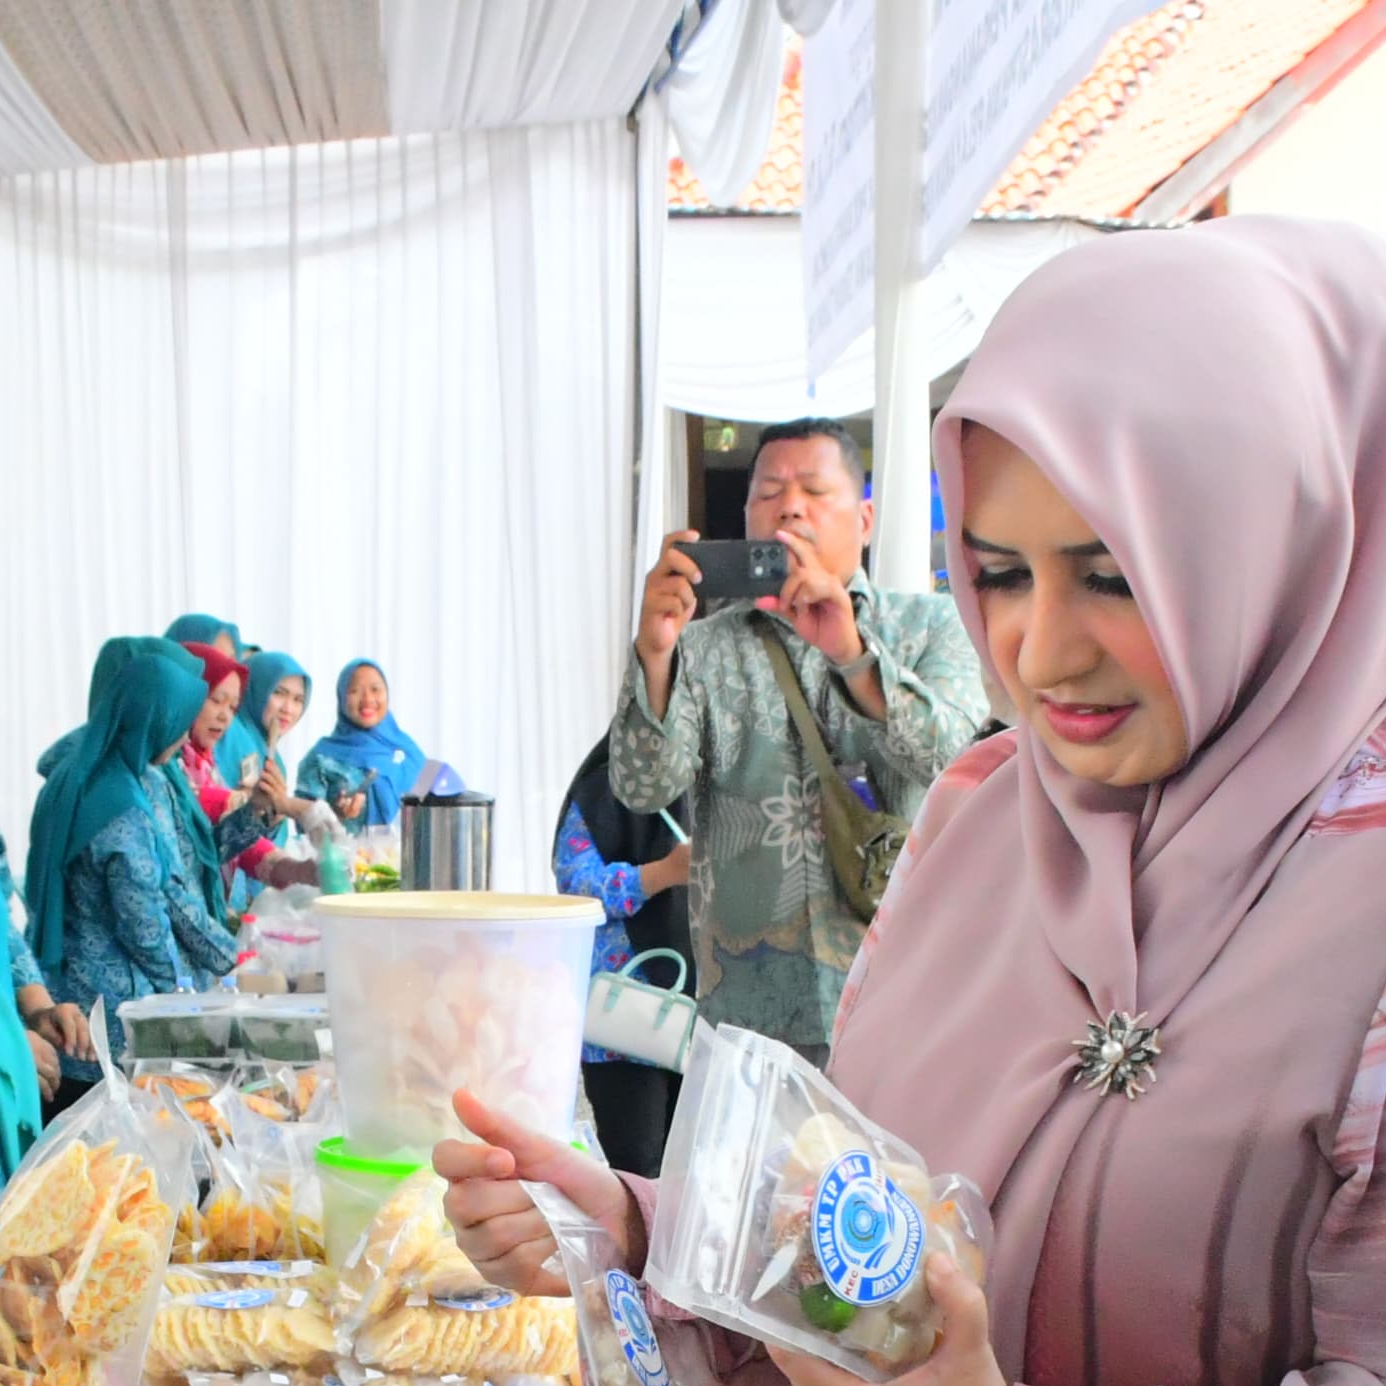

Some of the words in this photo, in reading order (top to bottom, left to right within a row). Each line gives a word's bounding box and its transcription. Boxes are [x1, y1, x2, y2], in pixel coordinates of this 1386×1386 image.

[821, 1180, 839, 1207] TP
[818, 1213, 841, 1273] UMKM
[844, 1270, 859, 1297] KEC
